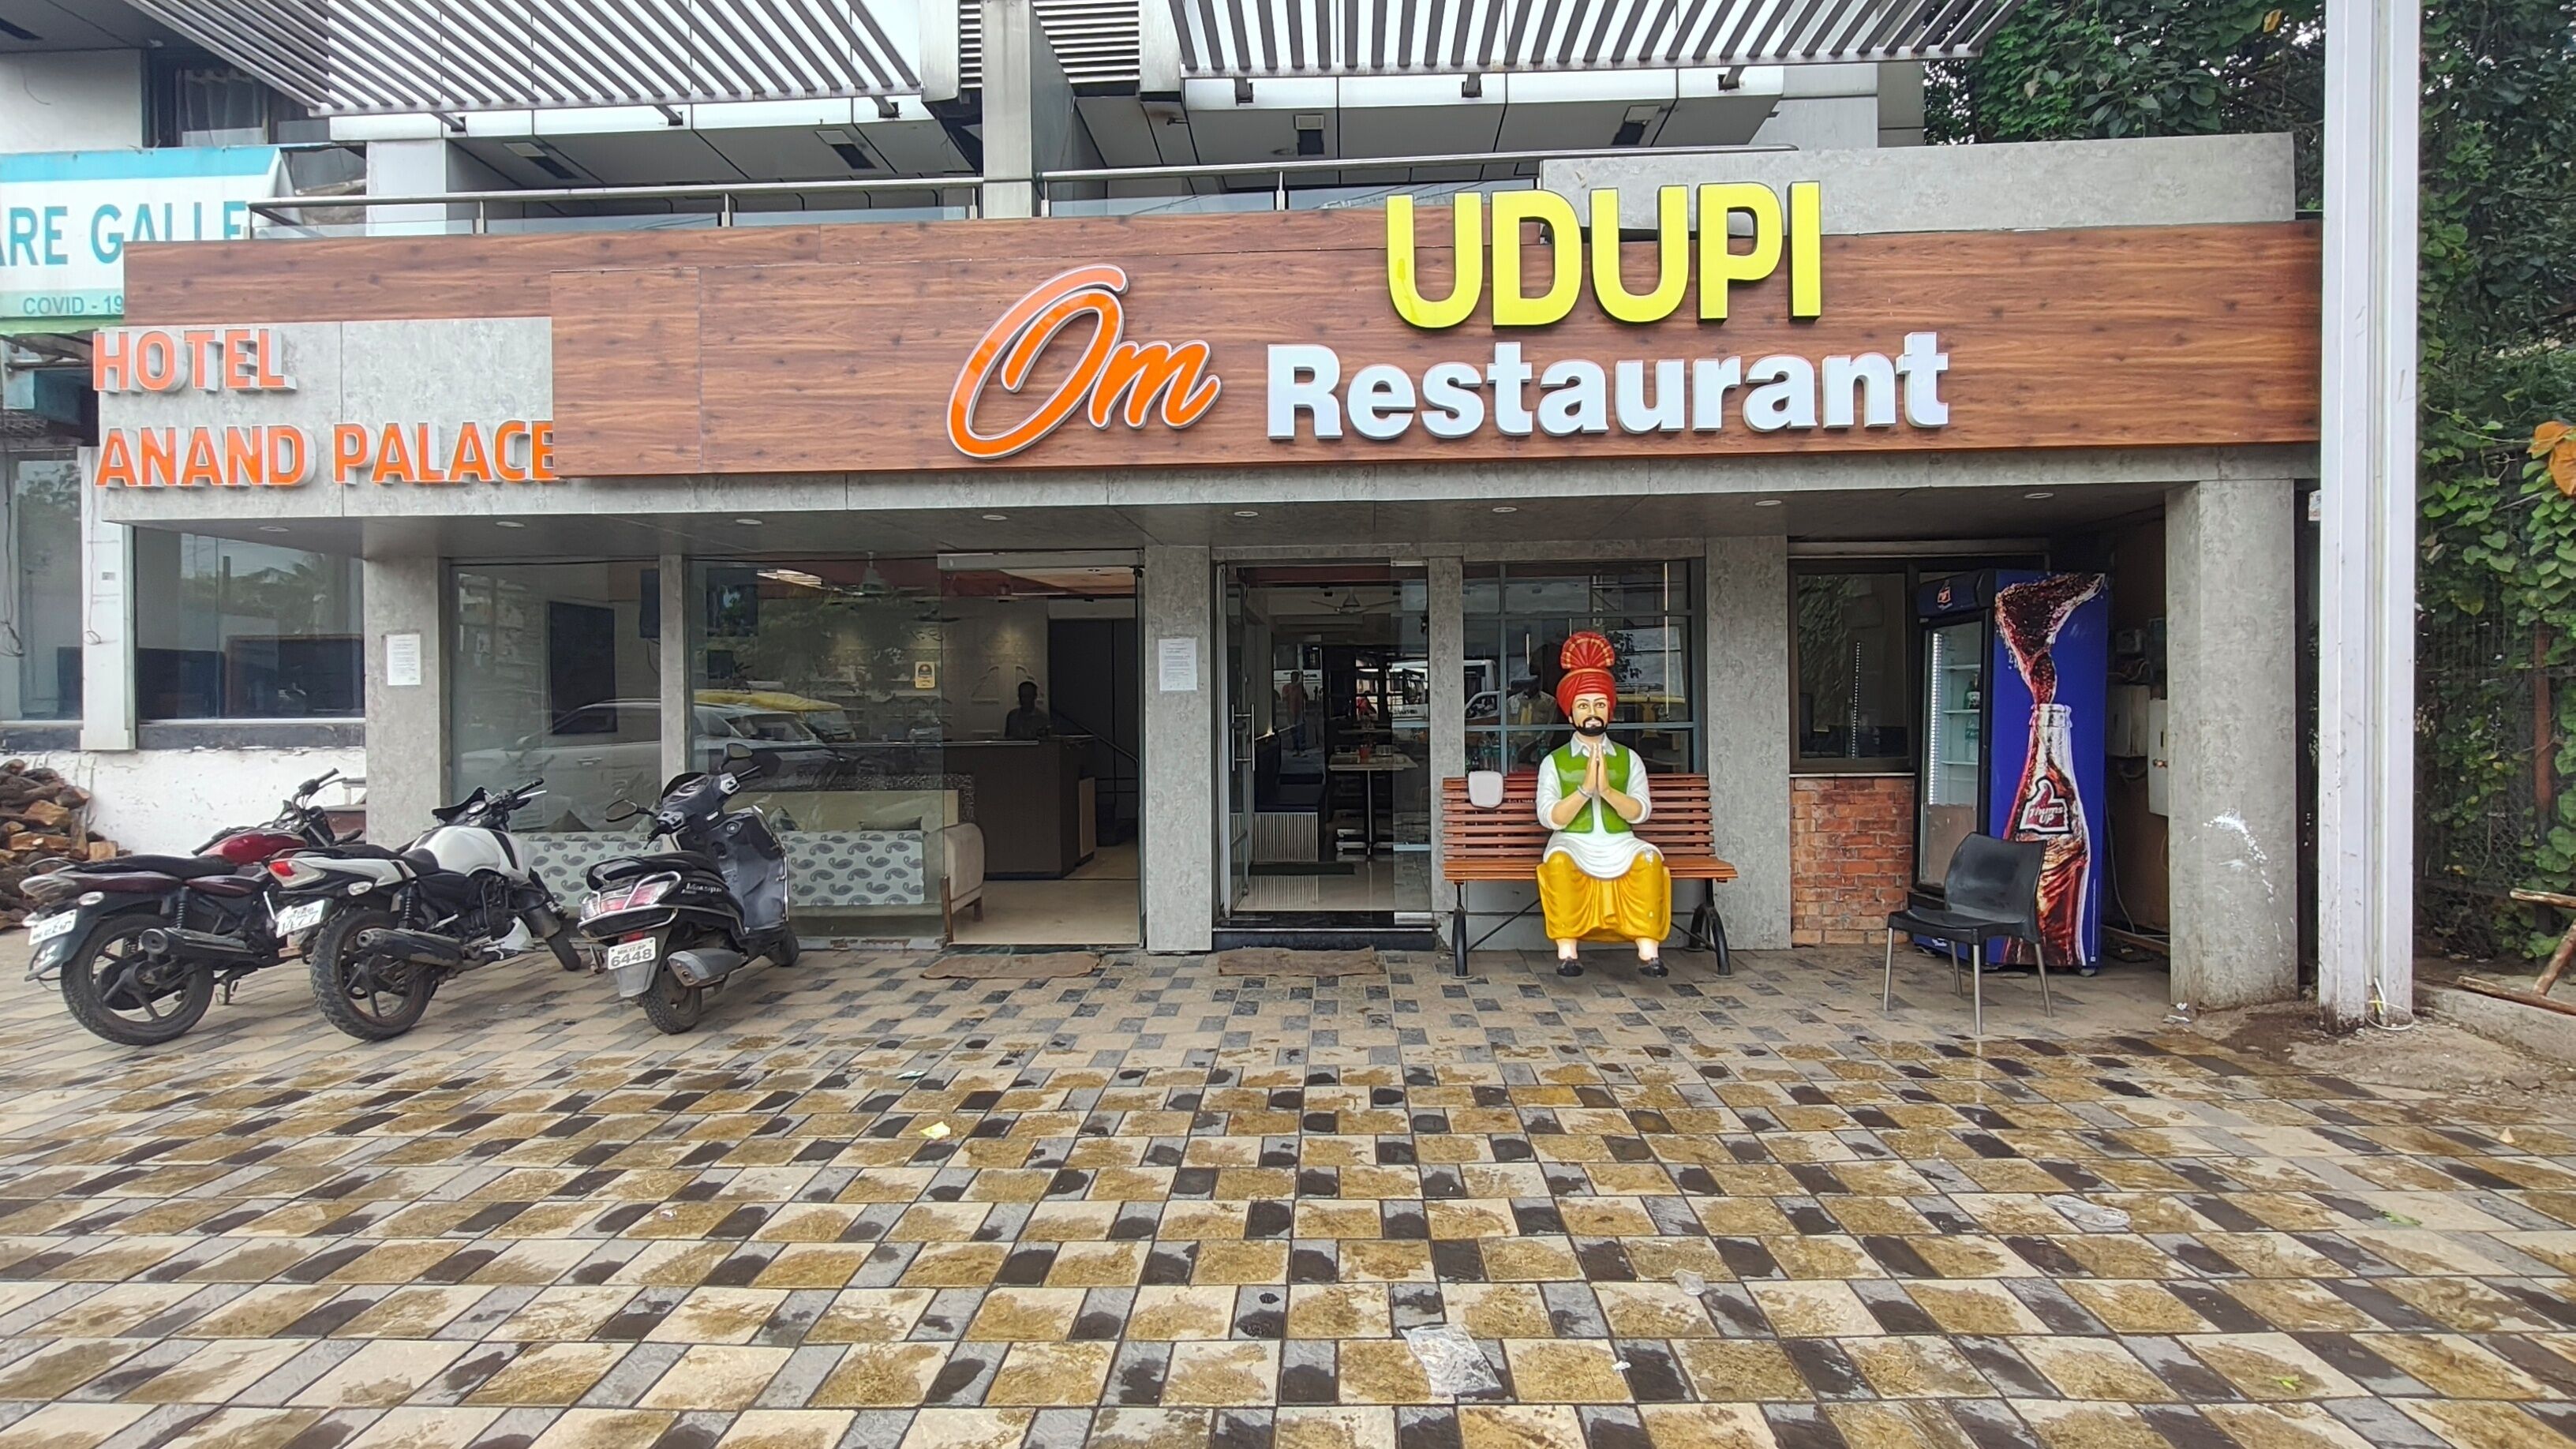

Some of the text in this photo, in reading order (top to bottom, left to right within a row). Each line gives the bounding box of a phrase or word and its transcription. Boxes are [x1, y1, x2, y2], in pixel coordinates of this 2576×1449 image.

[0, 205, 68, 267] RE
[1385, 181, 1822, 329] UDUPI
[23, 297, 84, 315] COVID
[92, 328, 295, 393] HOTEL
[947, 264, 1221, 459] Om
[1267, 331, 1949, 441] Restaurant
[94, 419, 557, 487] ANAND PALACE
[2029, 806, 2063, 819] Thums
[611, 948, 653, 968] 6448
